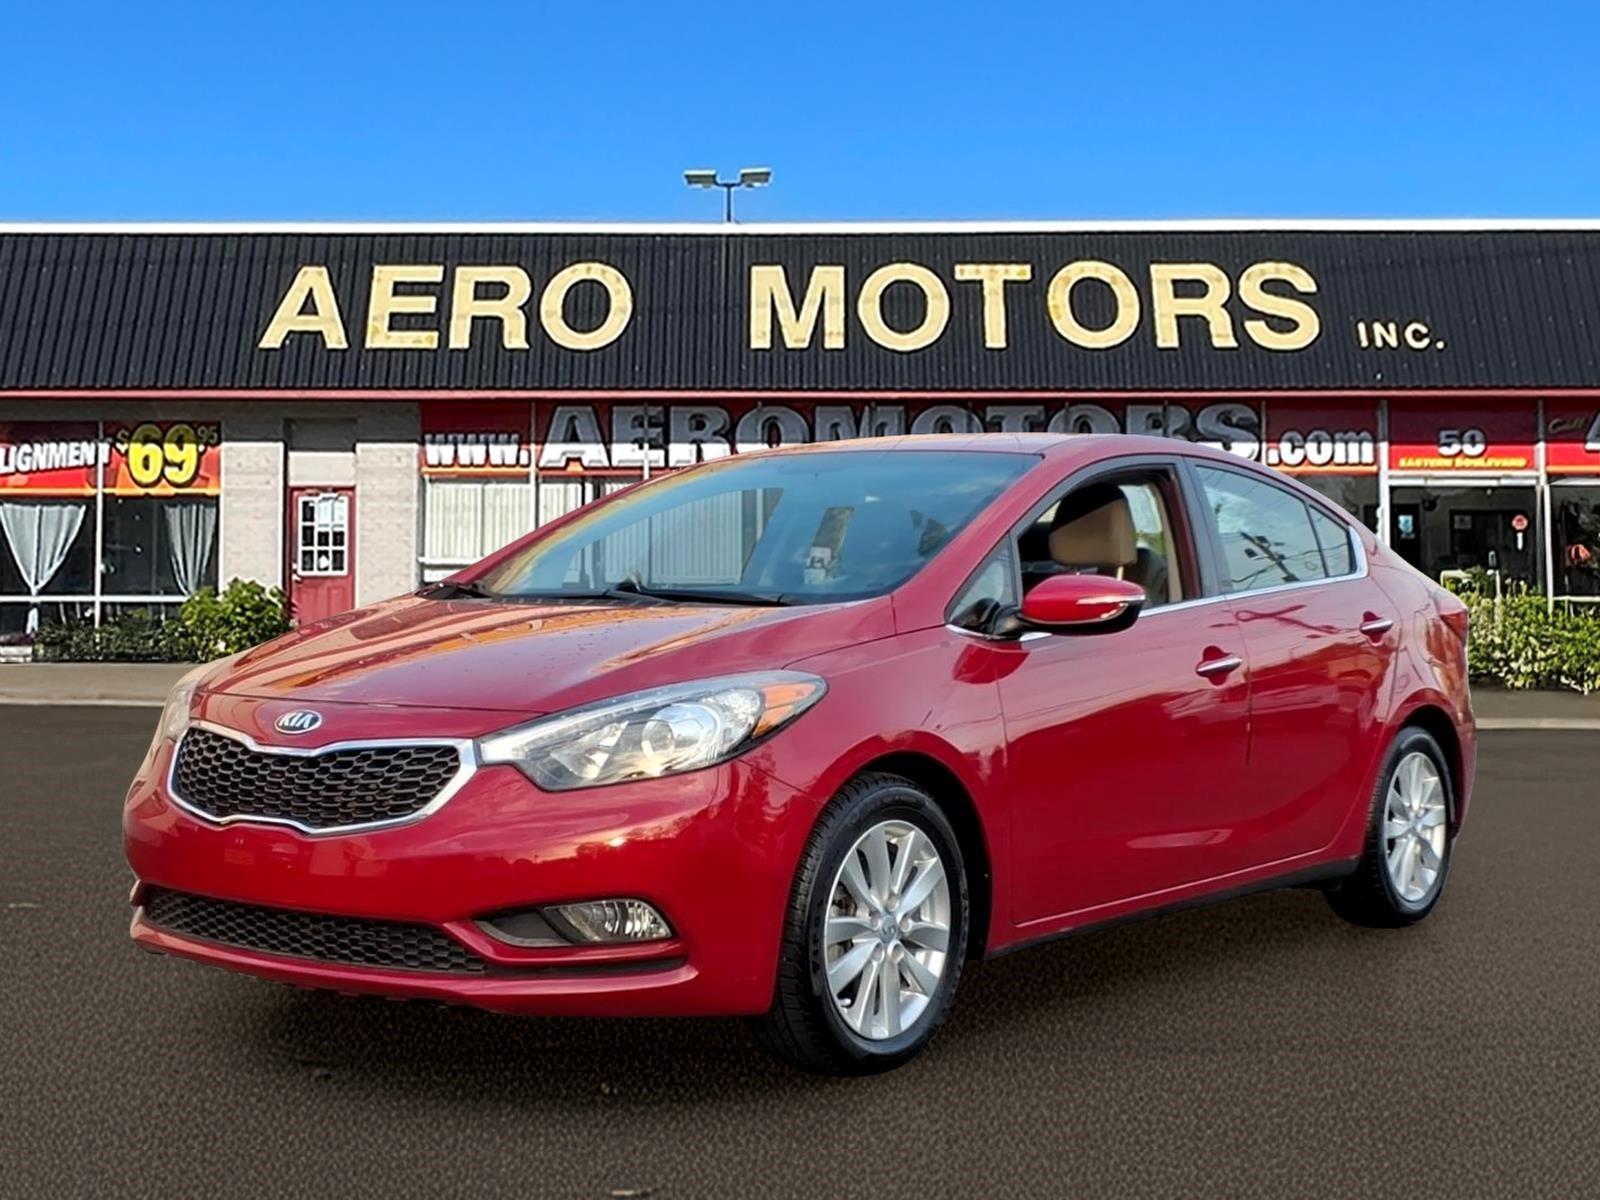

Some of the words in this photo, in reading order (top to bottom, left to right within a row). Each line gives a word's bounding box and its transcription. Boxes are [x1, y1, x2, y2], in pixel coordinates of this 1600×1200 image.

[258, 262, 633, 352] AERO
[749, 260, 1321, 353] MOTORS
[1357, 322, 1445, 349] INC.
[1438, 429, 1486, 456] 50
[277, 711, 316, 730] KIA
